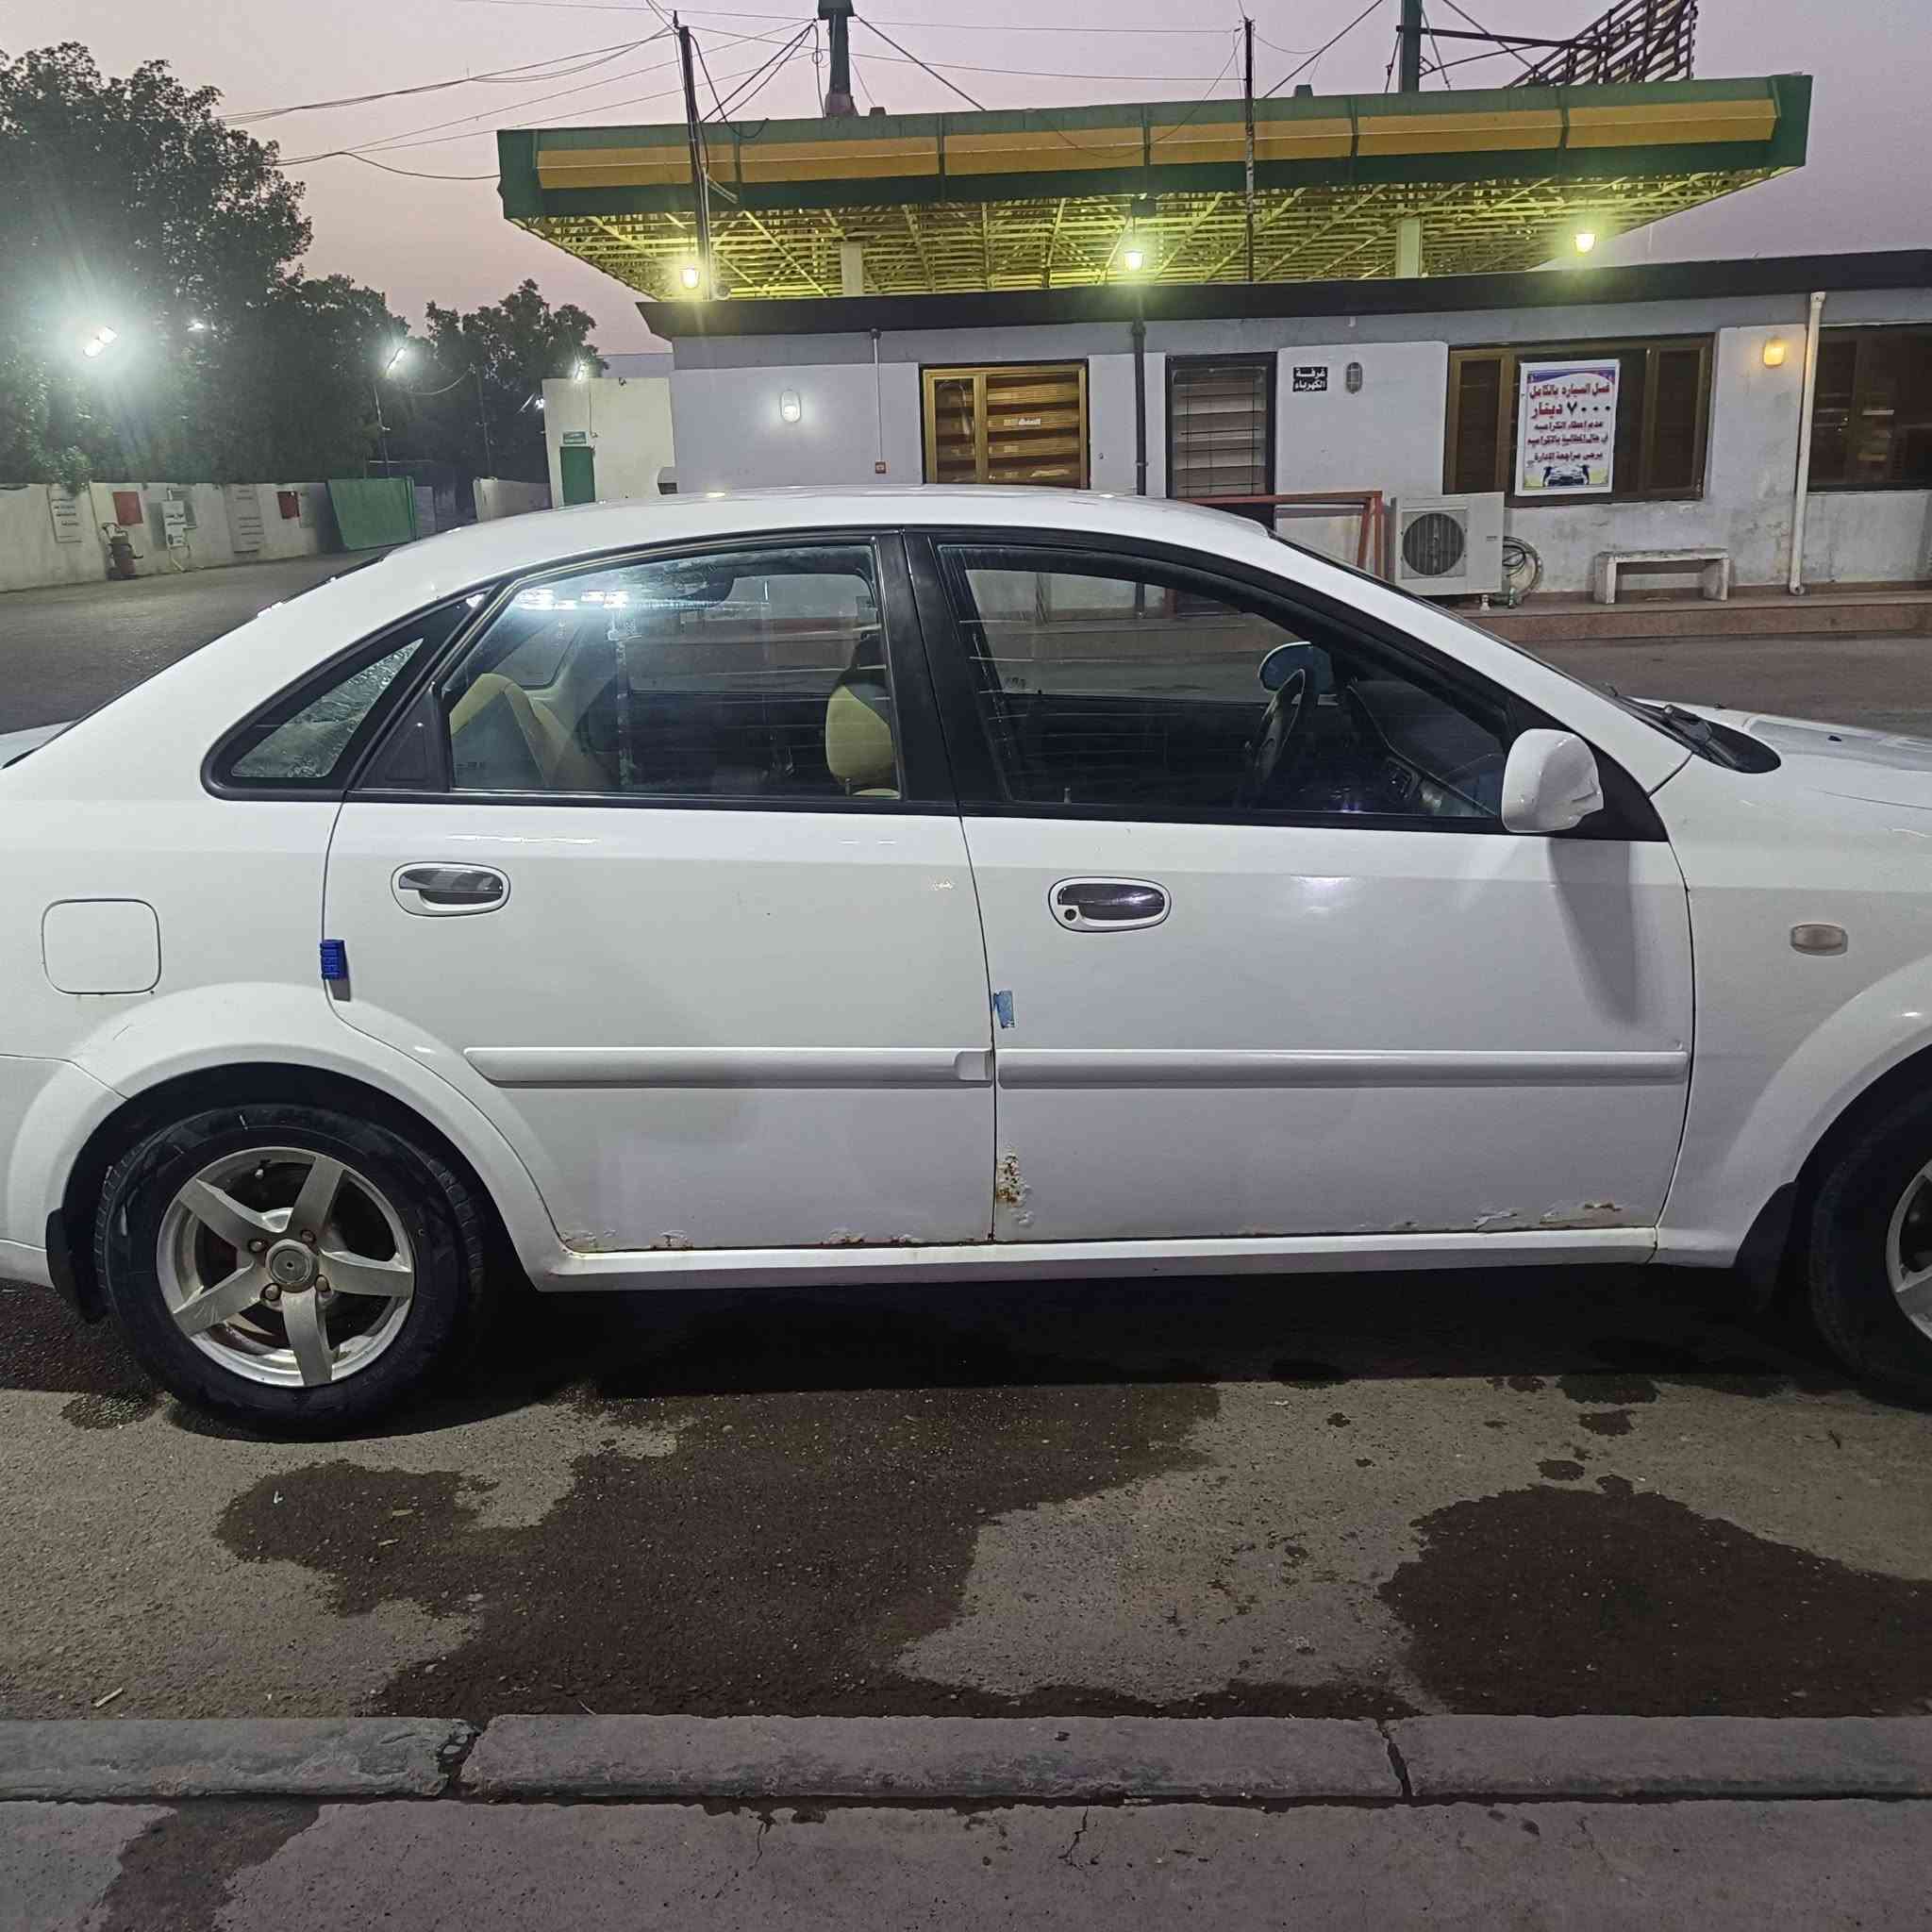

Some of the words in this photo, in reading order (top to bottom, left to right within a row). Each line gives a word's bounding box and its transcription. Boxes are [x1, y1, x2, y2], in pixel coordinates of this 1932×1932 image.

[1296, 368, 1325, 378] غرفة
[1295, 379, 1325, 391] الكهرباء
[1530, 384, 1558, 399] بالكامل
[1530, 402, 1563, 419] دينار
